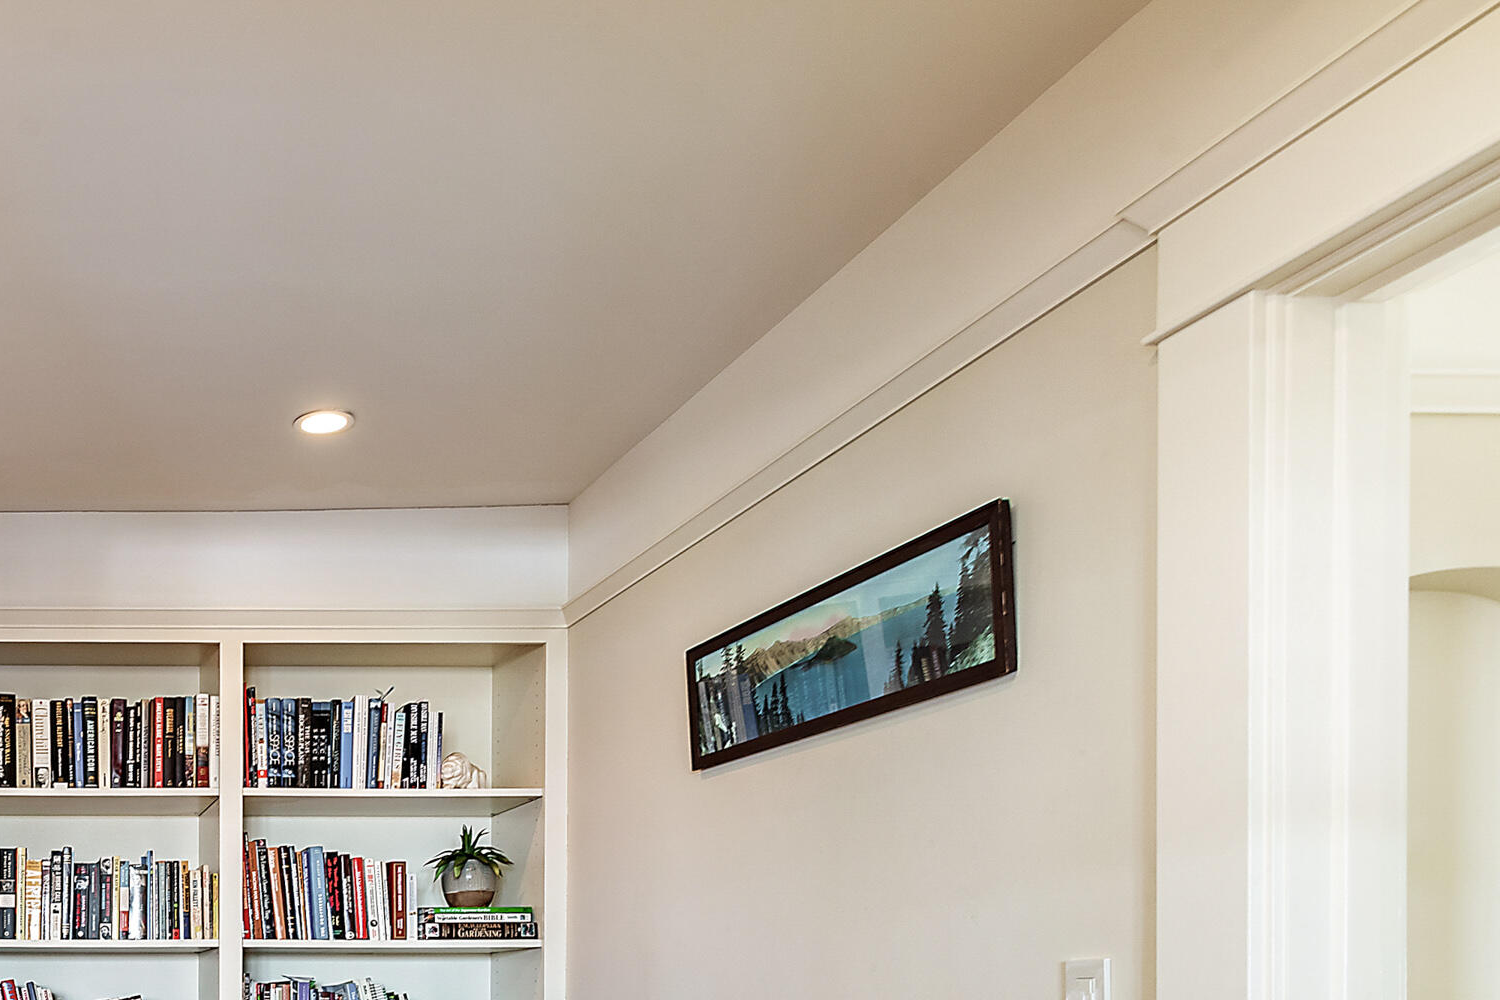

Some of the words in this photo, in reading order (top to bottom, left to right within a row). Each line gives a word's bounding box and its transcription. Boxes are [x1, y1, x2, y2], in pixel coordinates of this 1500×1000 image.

[35, 707, 49, 755] Churchill
[269, 734, 280, 766] SPACE
[284, 734, 295, 766] SPACE
[25, 869, 42, 914] AFRICA
[457, 929, 502, 938] GARDENING
